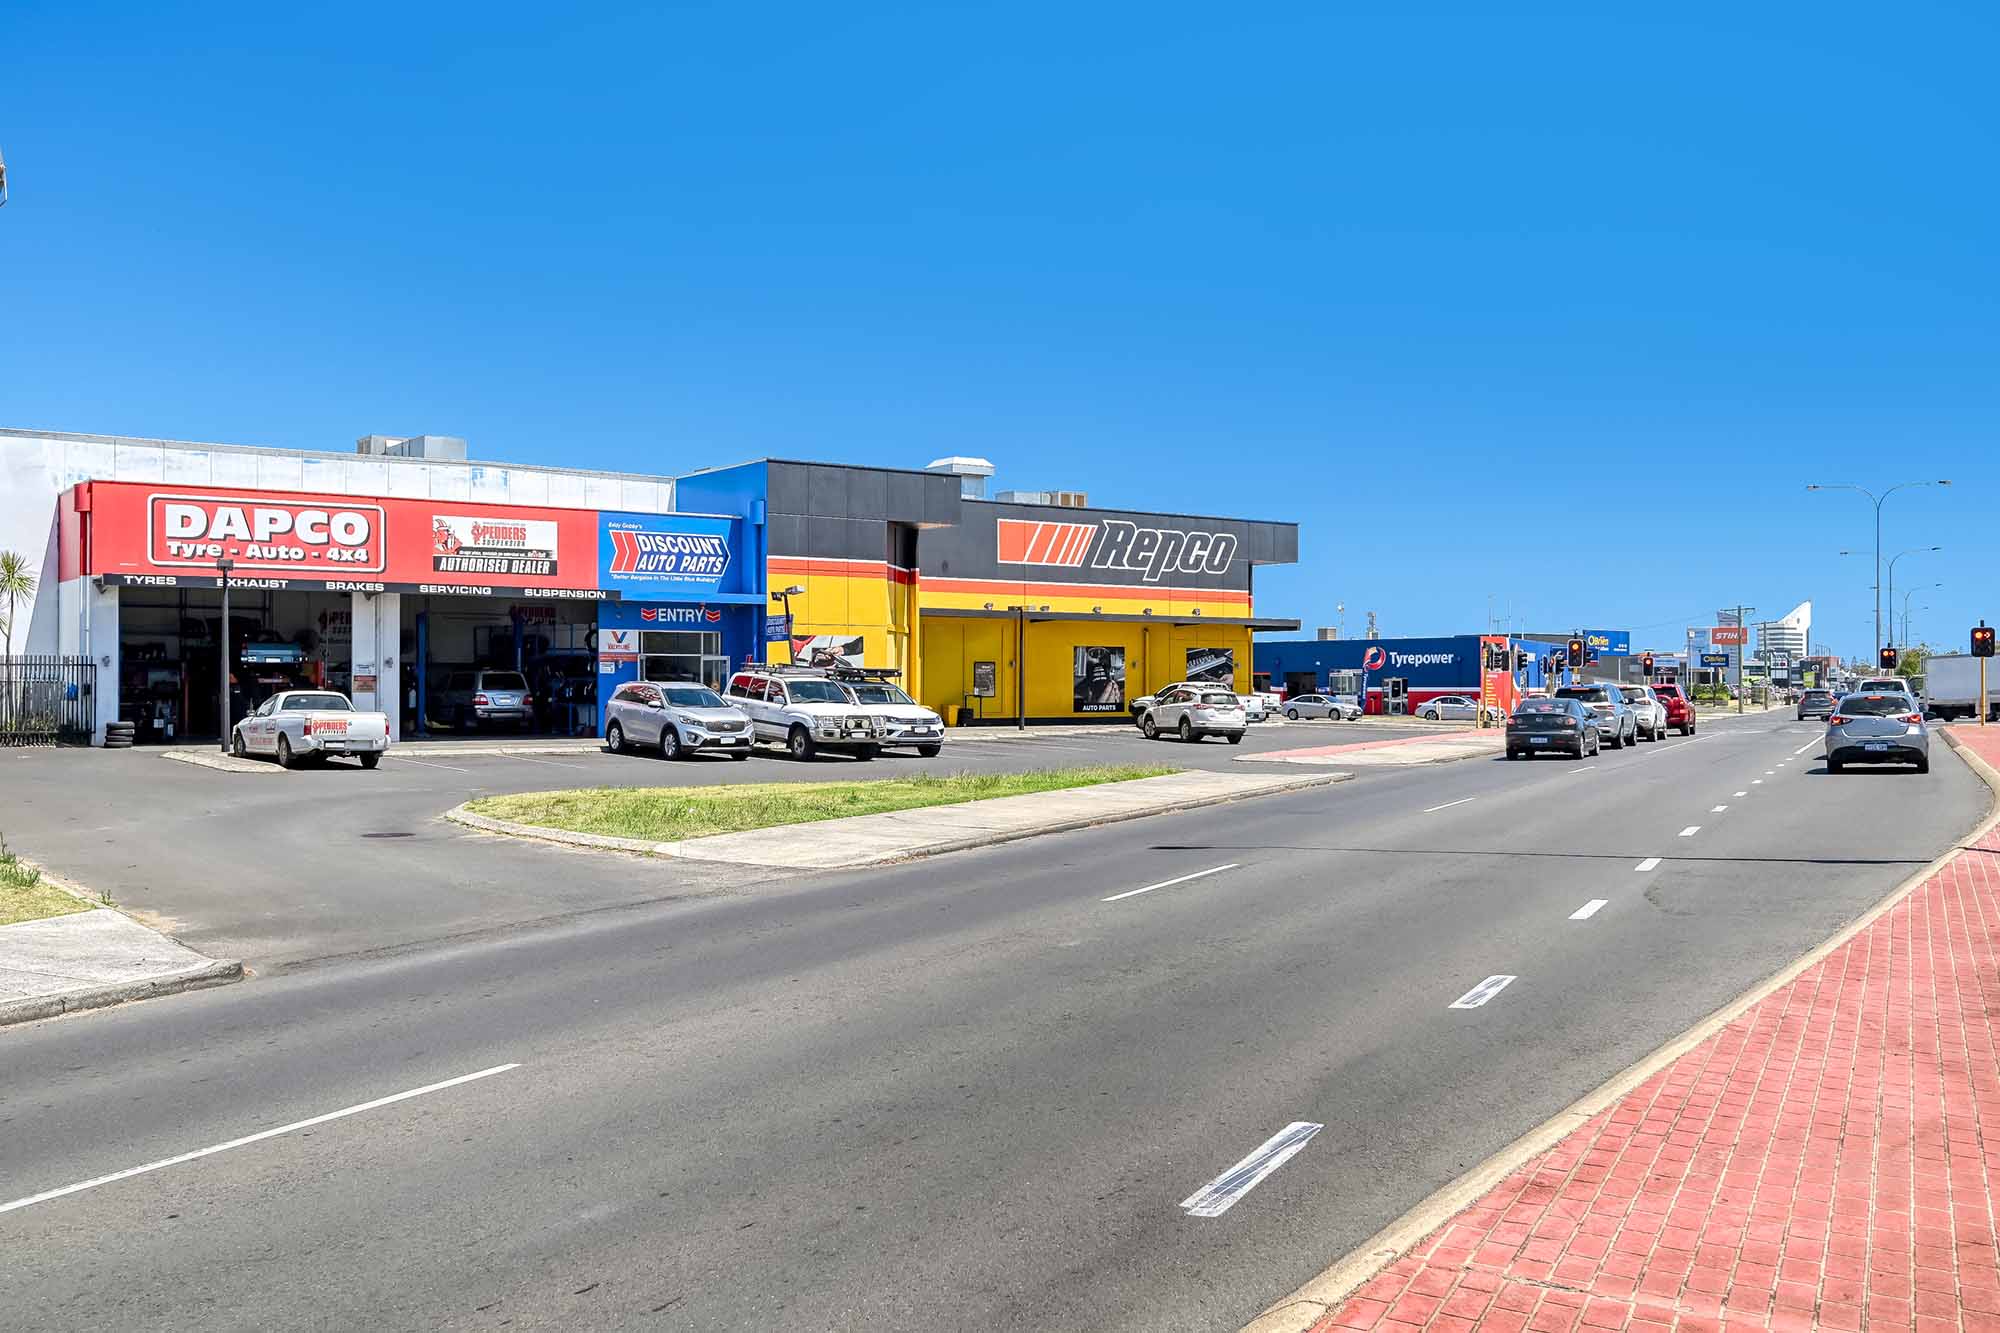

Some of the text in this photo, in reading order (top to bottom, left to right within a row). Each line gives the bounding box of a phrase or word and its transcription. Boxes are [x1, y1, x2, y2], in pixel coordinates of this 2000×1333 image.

[165, 504, 370, 546] DAPCO
[481, 526, 527, 540] PEDDERS
[637, 534, 723, 555] DISCOUNT
[1091, 520, 1238, 582] Repco
[167, 541, 224, 559] Tyre
[245, 544, 305, 560] Auto
[326, 547, 369, 563] 4x4
[440, 557, 551, 574] AUTHORISED DEALER
[637, 554, 724, 573] AUTO PARTS
[124, 576, 177, 585] TYRES
[216, 578, 289, 588] EXHAUST
[325, 581, 385, 591] BRAKES
[419, 585, 492, 595] SERVICING
[524, 588, 607, 599] SUSPENSION
[658, 608, 704, 622] ENTRY
[1715, 632, 1740, 640] STIH
[1389, 652, 1454, 667] Tyrepower
